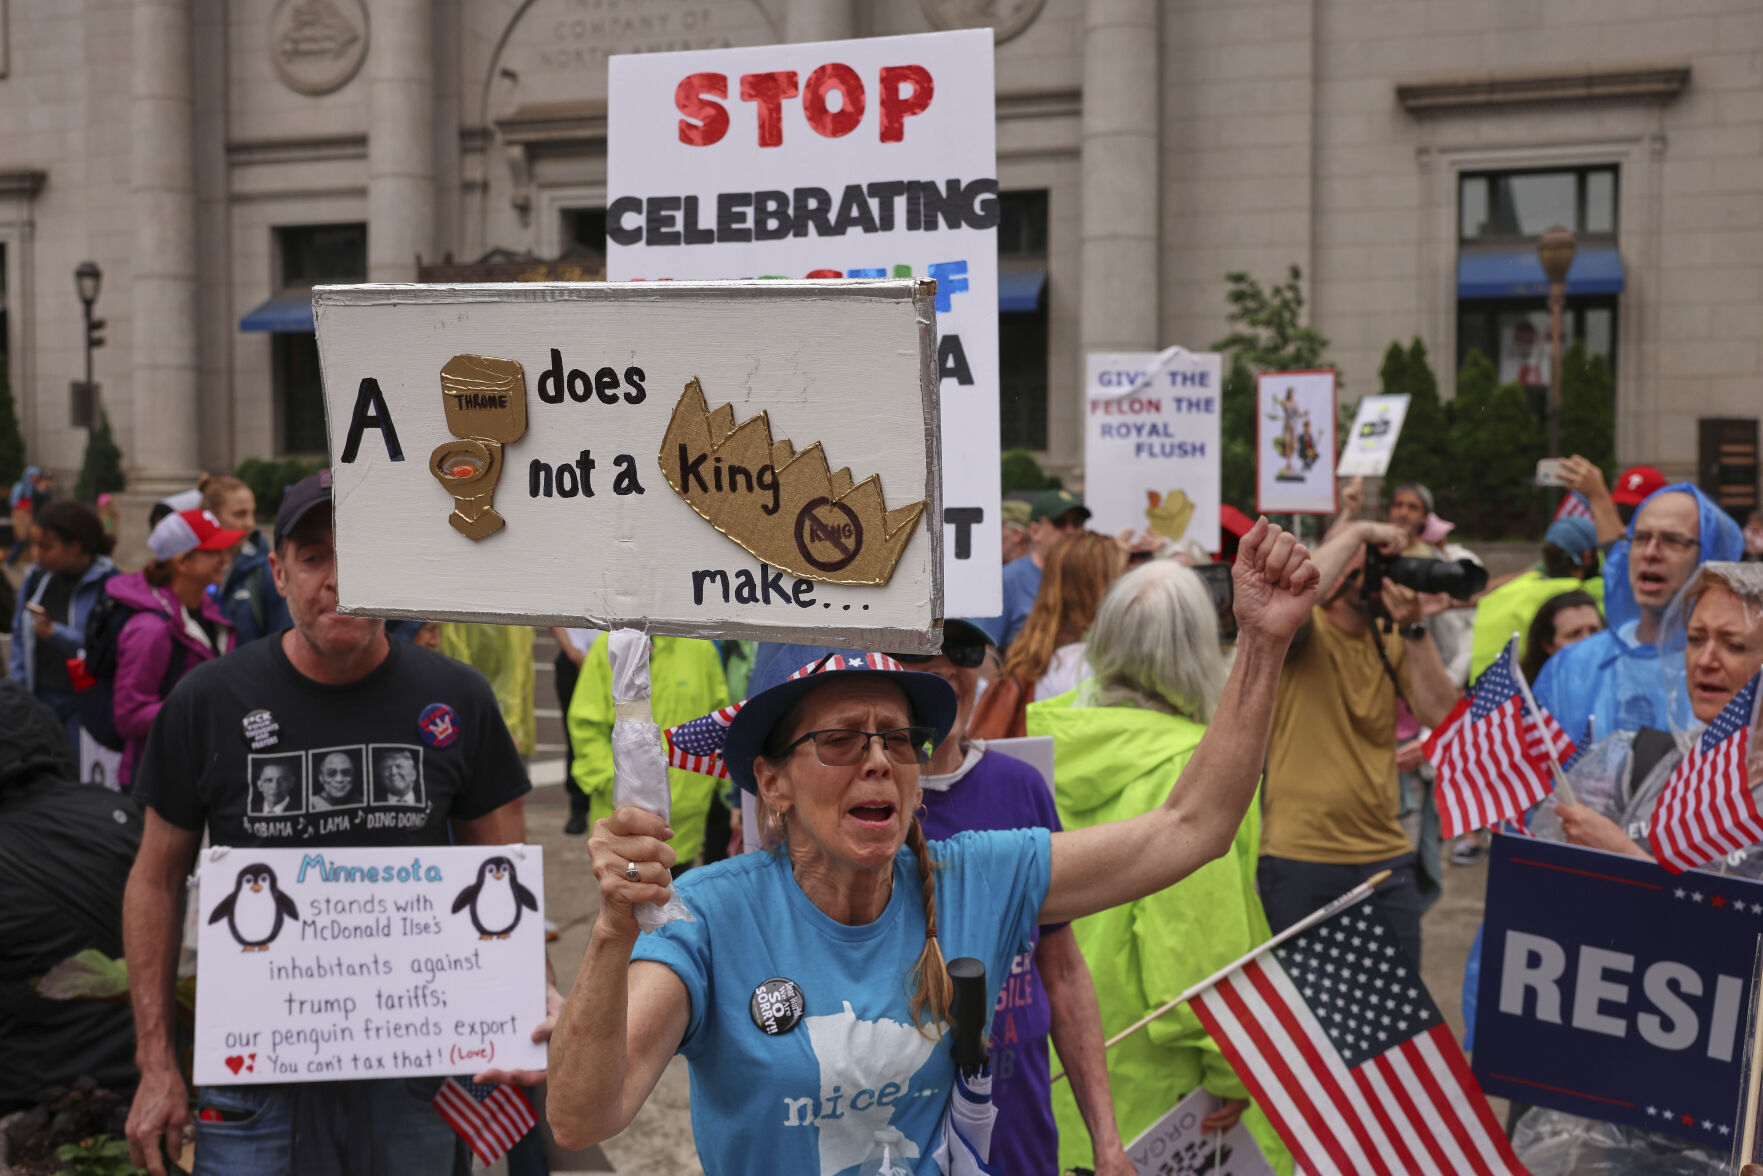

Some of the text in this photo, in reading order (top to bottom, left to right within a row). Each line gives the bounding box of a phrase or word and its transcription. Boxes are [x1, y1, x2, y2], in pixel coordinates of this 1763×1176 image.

[540, 46, 616, 69] NORT
[674, 62, 934, 148] STOP
[606, 178, 1000, 246] CELEBRATING
[1168, 370, 1210, 388] THE
[341, 348, 647, 463] A does
[455, 393, 507, 411] THRONE
[1090, 397, 1215, 415] FELON THE
[1101, 422, 1174, 438] ROYAL
[1135, 442, 1206, 458] FLUSH
[529, 449, 596, 498] not
[613, 454, 645, 496] a
[253, 821, 293, 837] OBAMA
[320, 815, 351, 835] LAMA
[367, 811, 396, 829] DING
[297, 853, 443, 883] Minnesota
[310, 893, 434, 917] stands with
[301, 916, 391, 941] McDonald
[269, 948, 482, 984] inhabitants against
[284, 985, 447, 1020] trump tariffs;
[755, 986, 779, 1035] SORRY!!
[768, 991, 785, 1018] SO
[1498, 929, 1743, 1063] RESI
[225, 1015, 517, 1055] our penguin friends export
[267, 1054, 299, 1074] You
[352, 1054, 385, 1071] tax
[450, 1040, 495, 1065] (Love)
[1134, 1112, 1197, 1167] ORGA
